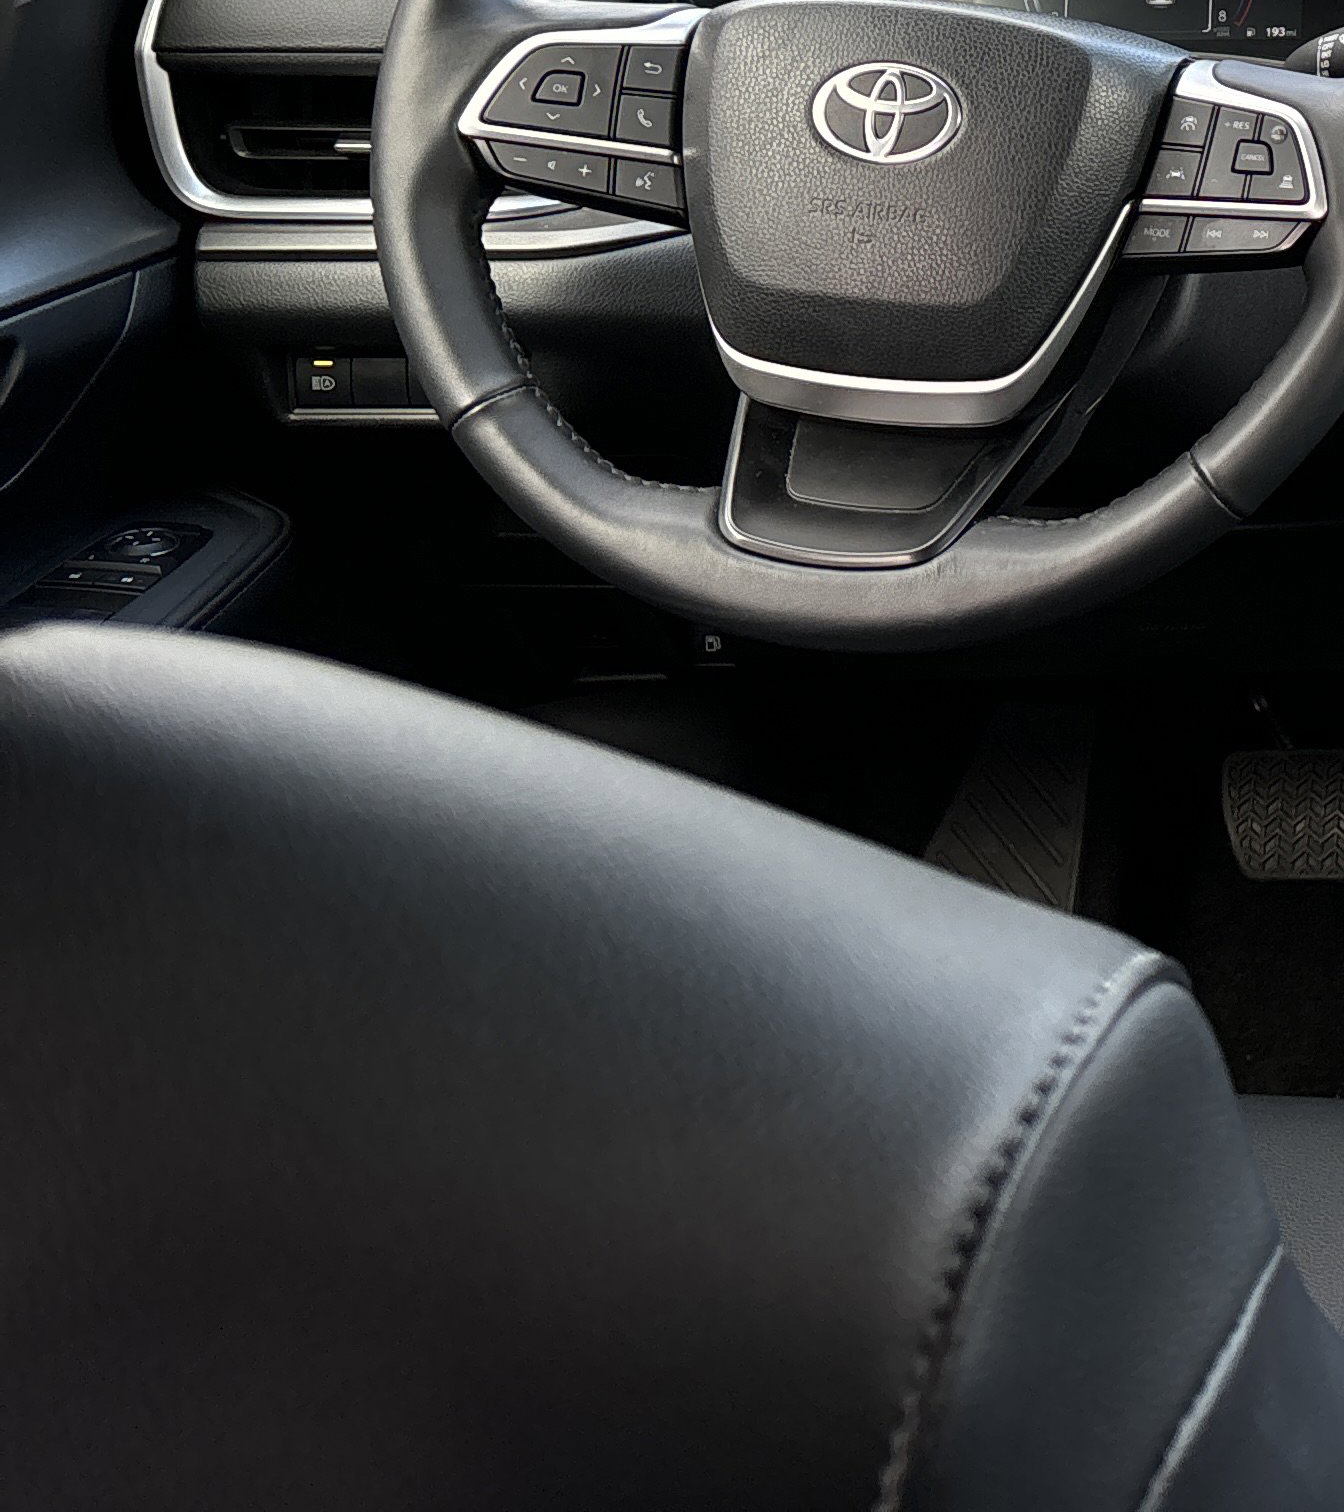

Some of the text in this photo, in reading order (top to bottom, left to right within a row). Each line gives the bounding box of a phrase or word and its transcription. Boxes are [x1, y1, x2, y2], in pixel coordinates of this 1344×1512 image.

[1217, 9, 1227, 23] 8
[1266, 26, 1286, 37] 193
[552, 83, 569, 94] OK
[1232, 121, 1250, 130] RES
[808, 197, 929, 224] SRS AIRBAG
[1143, 227, 1171, 238] MODE
